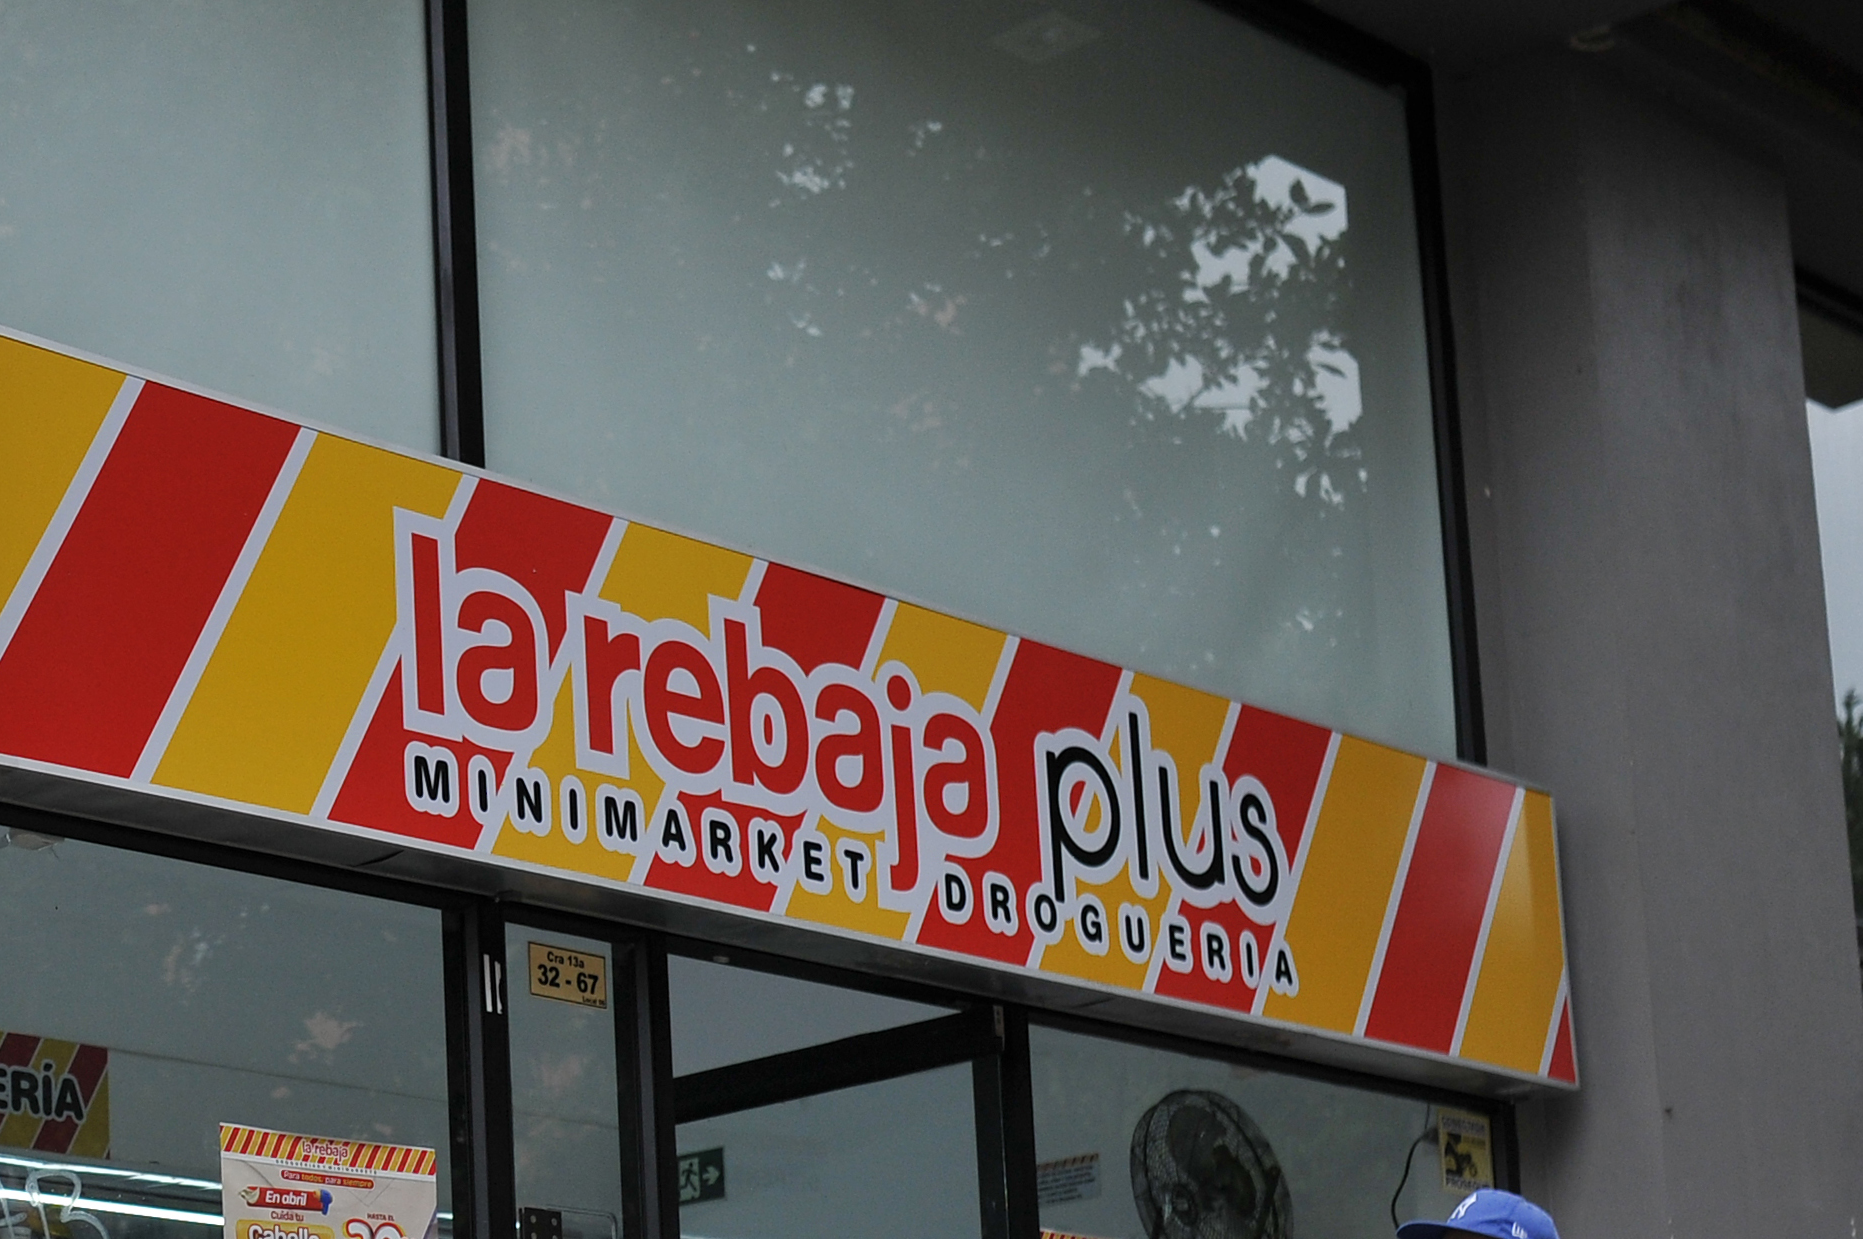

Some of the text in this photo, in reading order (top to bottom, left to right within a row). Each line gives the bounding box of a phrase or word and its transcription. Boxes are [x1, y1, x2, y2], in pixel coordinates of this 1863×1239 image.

[408, 532, 1278, 906] la rebaja plus
[413, 755, 1295, 989] MINIMARKET DROGUERIA
[547, 951, 585, 969] Cra 13a
[537, 964, 560, 988] 32
[576, 972, 599, 995] 67
[302, 1141, 348, 1161] la rebaja
[325, 1177, 342, 1187] para
[343, 1178, 372, 1189] siempre
[265, 1190, 307, 1206] En abril
[271, 1211, 304, 1222] Cuida tu
